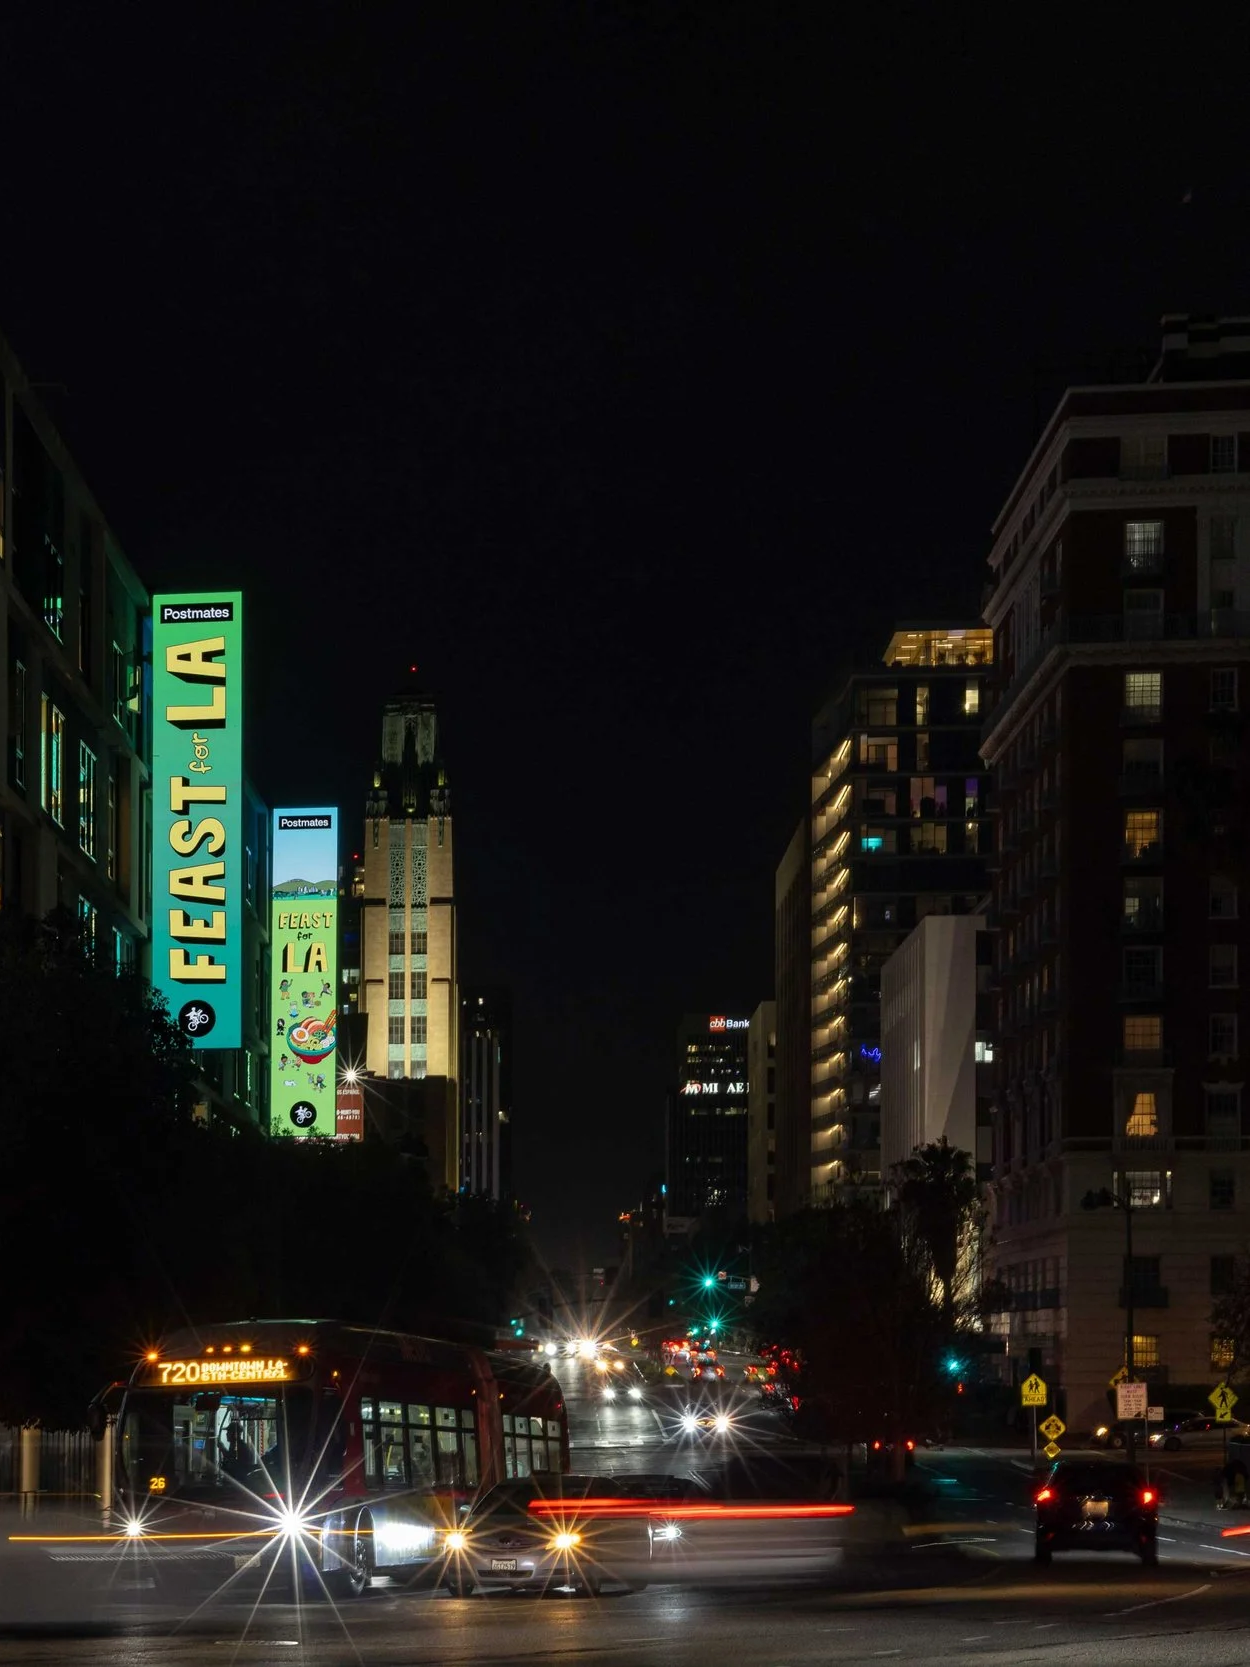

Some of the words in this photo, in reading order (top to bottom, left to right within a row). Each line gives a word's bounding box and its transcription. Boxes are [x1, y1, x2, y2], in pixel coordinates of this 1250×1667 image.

[163, 606, 230, 622] Postmates
[165, 635, 227, 730] LA
[187, 731, 213, 775] for
[281, 817, 329, 828] Postmates
[168, 775, 227, 985] FEAST
[278, 911, 333, 930] FEAST
[296, 931, 313, 942] for
[281, 941, 329, 974] LA
[726, 1019, 750, 1029] Bank
[702, 1082, 744, 1095] MIAE
[158, 1361, 201, 1383] 720
[201, 1360, 265, 1372] DOWNTOWN
[201, 1368, 288, 1381] 6TH-CENTRAL
[150, 1477, 166, 1489] 26
